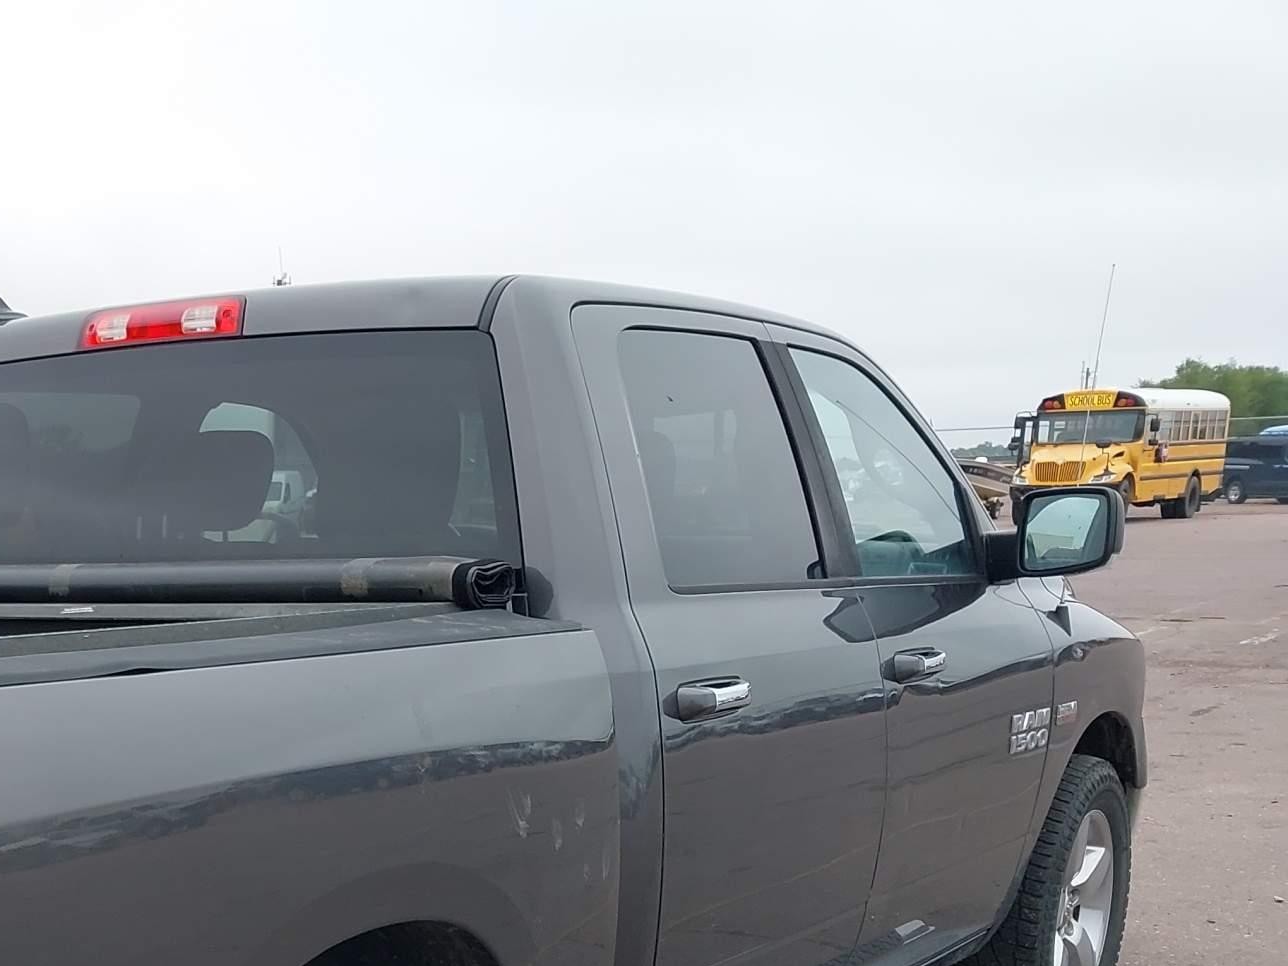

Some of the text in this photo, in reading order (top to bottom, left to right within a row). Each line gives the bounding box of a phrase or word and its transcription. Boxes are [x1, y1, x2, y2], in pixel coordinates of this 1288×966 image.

[1069, 394, 1112, 406] SCHOOL BUS
[1011, 707, 1051, 734] RAM
[1009, 728, 1049, 755] 1500
